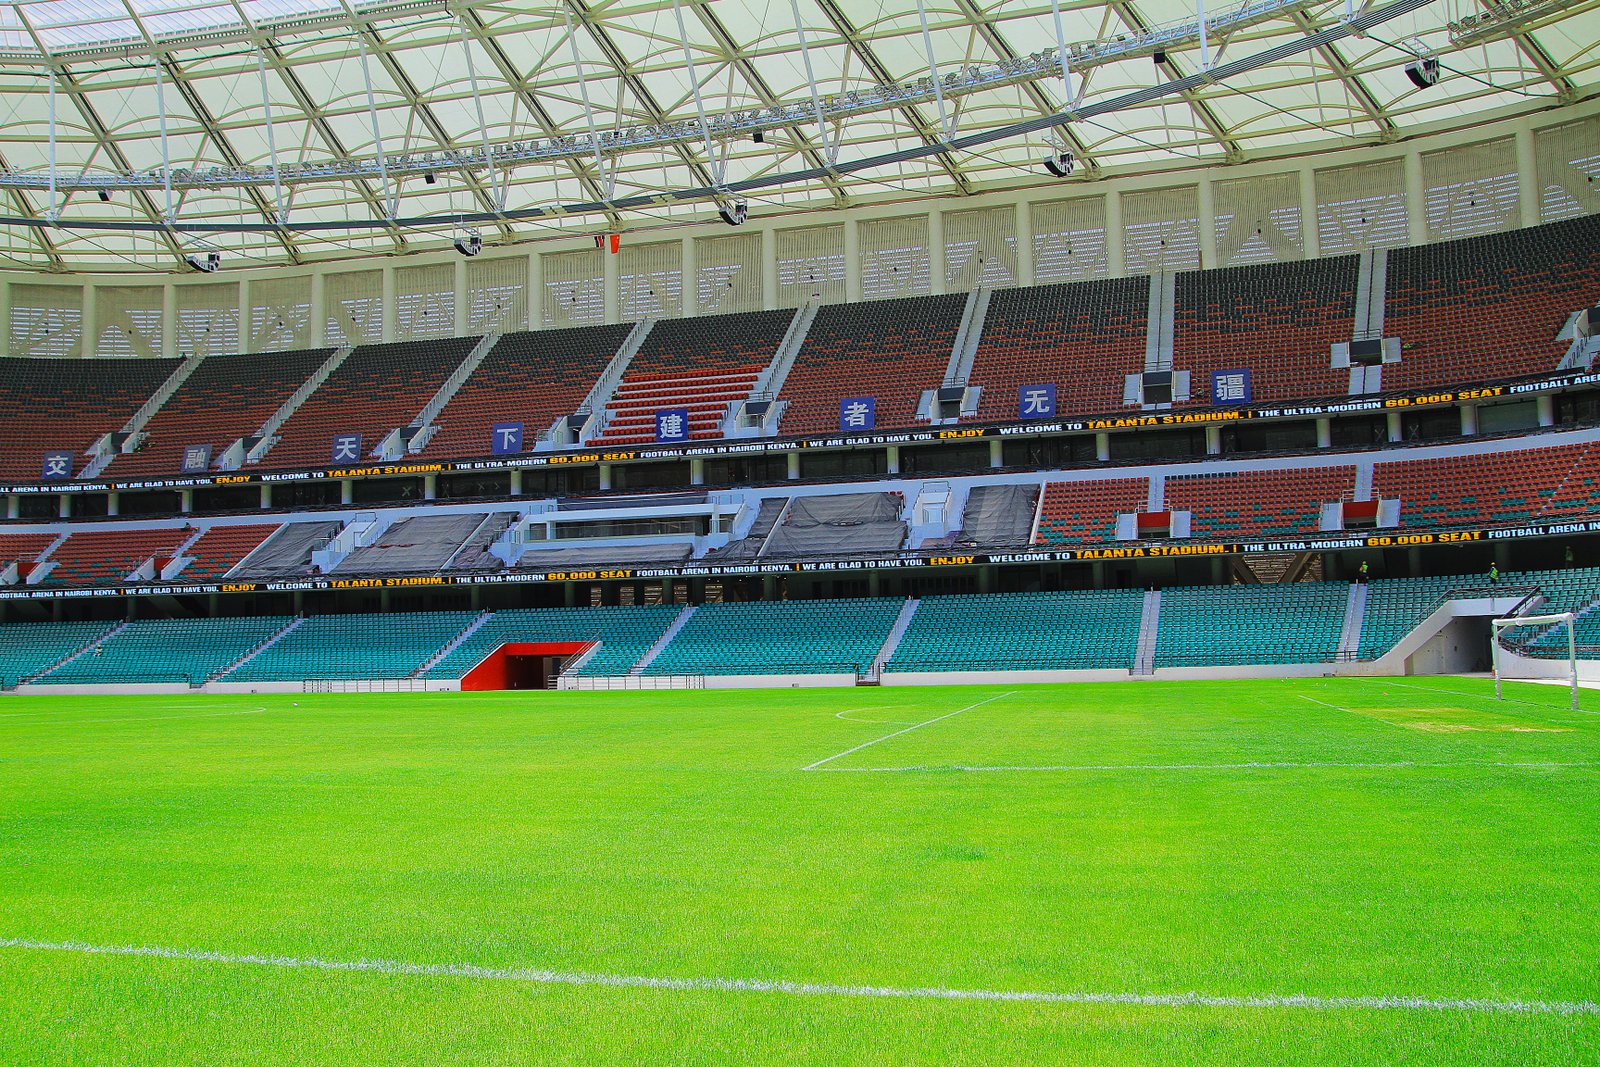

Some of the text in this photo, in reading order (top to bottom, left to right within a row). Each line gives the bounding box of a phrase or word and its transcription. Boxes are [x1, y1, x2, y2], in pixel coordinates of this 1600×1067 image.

[1216, 374, 1245, 400] 疆
[844, 401, 869, 426] 者
[1024, 389, 1050, 414] 无
[216, 476, 251, 484] ENJOY
[262, 473, 309, 482] WELCOME
[328, 468, 380, 477] TALANTA
[384, 464, 445, 474] STADIUM.
[475, 459, 547, 469] ULTRA-MODERN
[603, 452, 635, 460] SEAT
[641, 450, 683, 458] FOOTBALL
[729, 444, 765, 452] NAIROBI
[767, 442, 799, 450] KENYA.
[940, 429, 985, 438] ENJOY
[1000, 425, 1062, 435] WELCOME
[1086, 417, 1158, 429] TALANTA
[1163, 412, 1244, 424] STADIUM.
[1284, 402, 1381, 415] ULTRA-MODERN
[1458, 388, 1502, 401] SEAT
[1509, 380, 1570, 394] FOOTBALL
[659, 414, 683, 438] 建
[335, 437, 356, 460] 天
[496, 428, 518, 450] 下
[46, 455, 68, 475] 交
[185, 447, 206, 469] 融
[222, 584, 256, 592] ENJOY
[266, 582, 313, 590] WELCOME
[331, 579, 383, 588] TALANTA
[386, 577, 446, 586] STADIUM.
[474, 574, 545, 583] ULTRA-MODERN
[600, 570, 632, 579] SEAT
[637, 569, 679, 577] FOOTBALL
[819, 562, 836, 570] ARE
[838, 561, 861, 569] GLAD
[903, 559, 926, 567] YOU.
[930, 556, 974, 565] ENJOY
[989, 553, 1051, 563] WELCOME
[1055, 552, 1070, 560] TO
[1075, 548, 1145, 559] TALANTA
[1149, 545, 1229, 556] STADIUM.
[1243, 544, 1265, 552] THE
[1268, 539, 1363, 551] ULTRA-MODERN
[1438, 532, 1482, 542] SEAT
[1488, 527, 1545, 539] FOOTBALL
[1548, 523, 1585, 534] ARENA
[1589, 522, 1600, 530] IN
